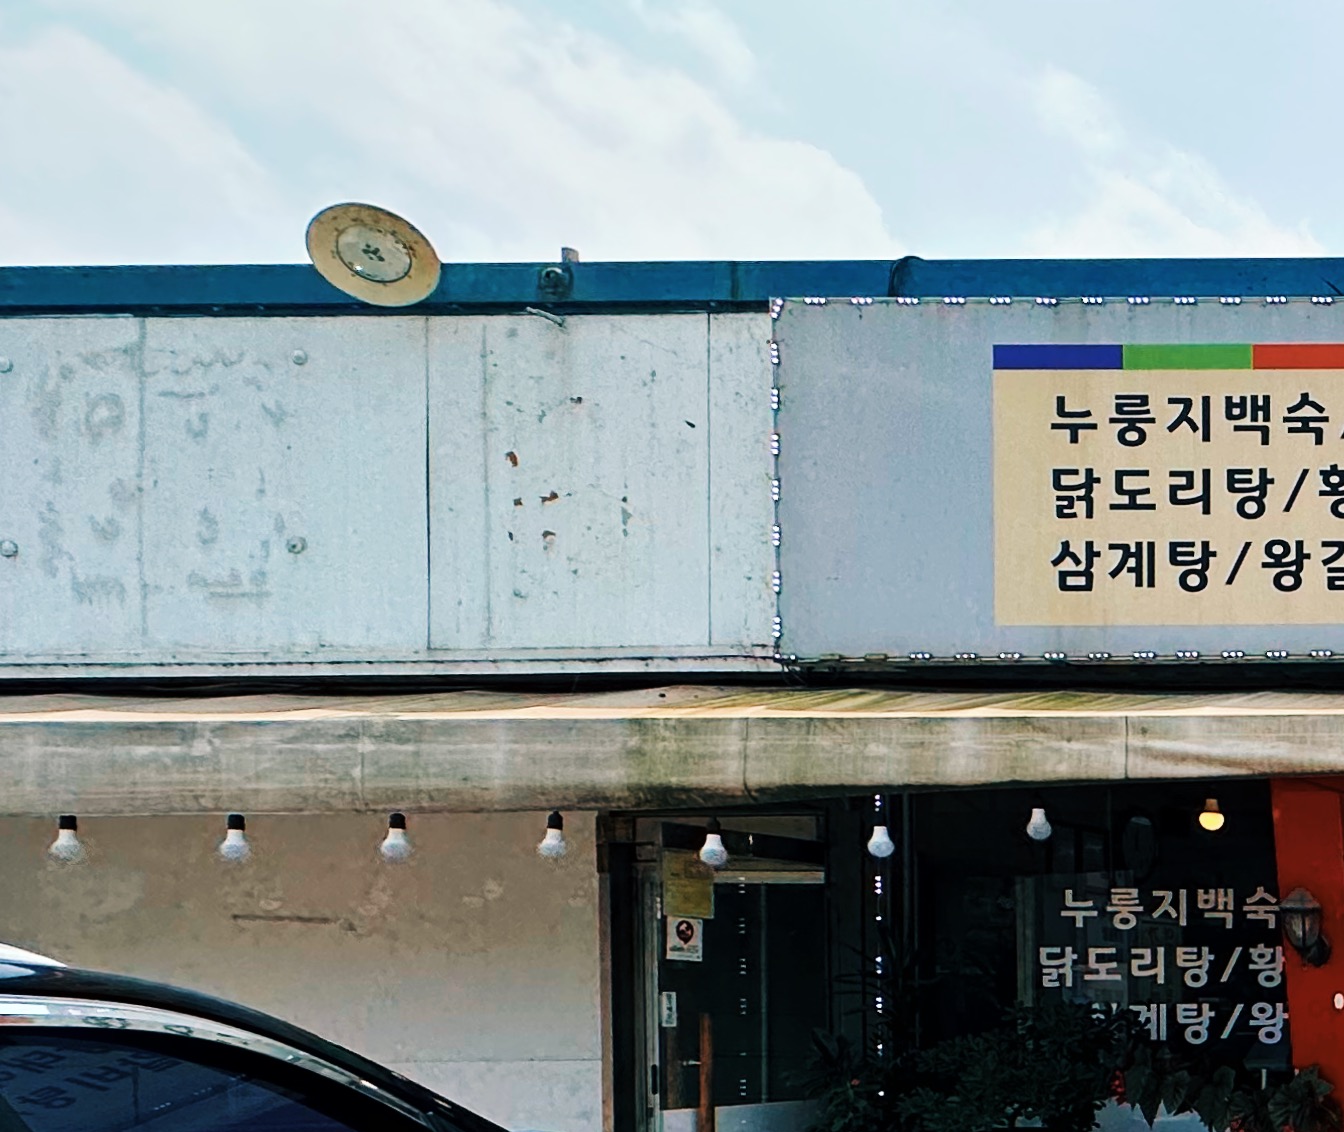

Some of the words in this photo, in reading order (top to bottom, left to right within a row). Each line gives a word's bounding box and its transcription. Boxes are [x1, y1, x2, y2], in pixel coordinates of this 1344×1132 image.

[1060, 886, 1281, 931] 누룽지백숙
[1038, 942, 1286, 989] 닭도리탕/황
[1091, 1001, 1290, 1046] 계탕/왕
